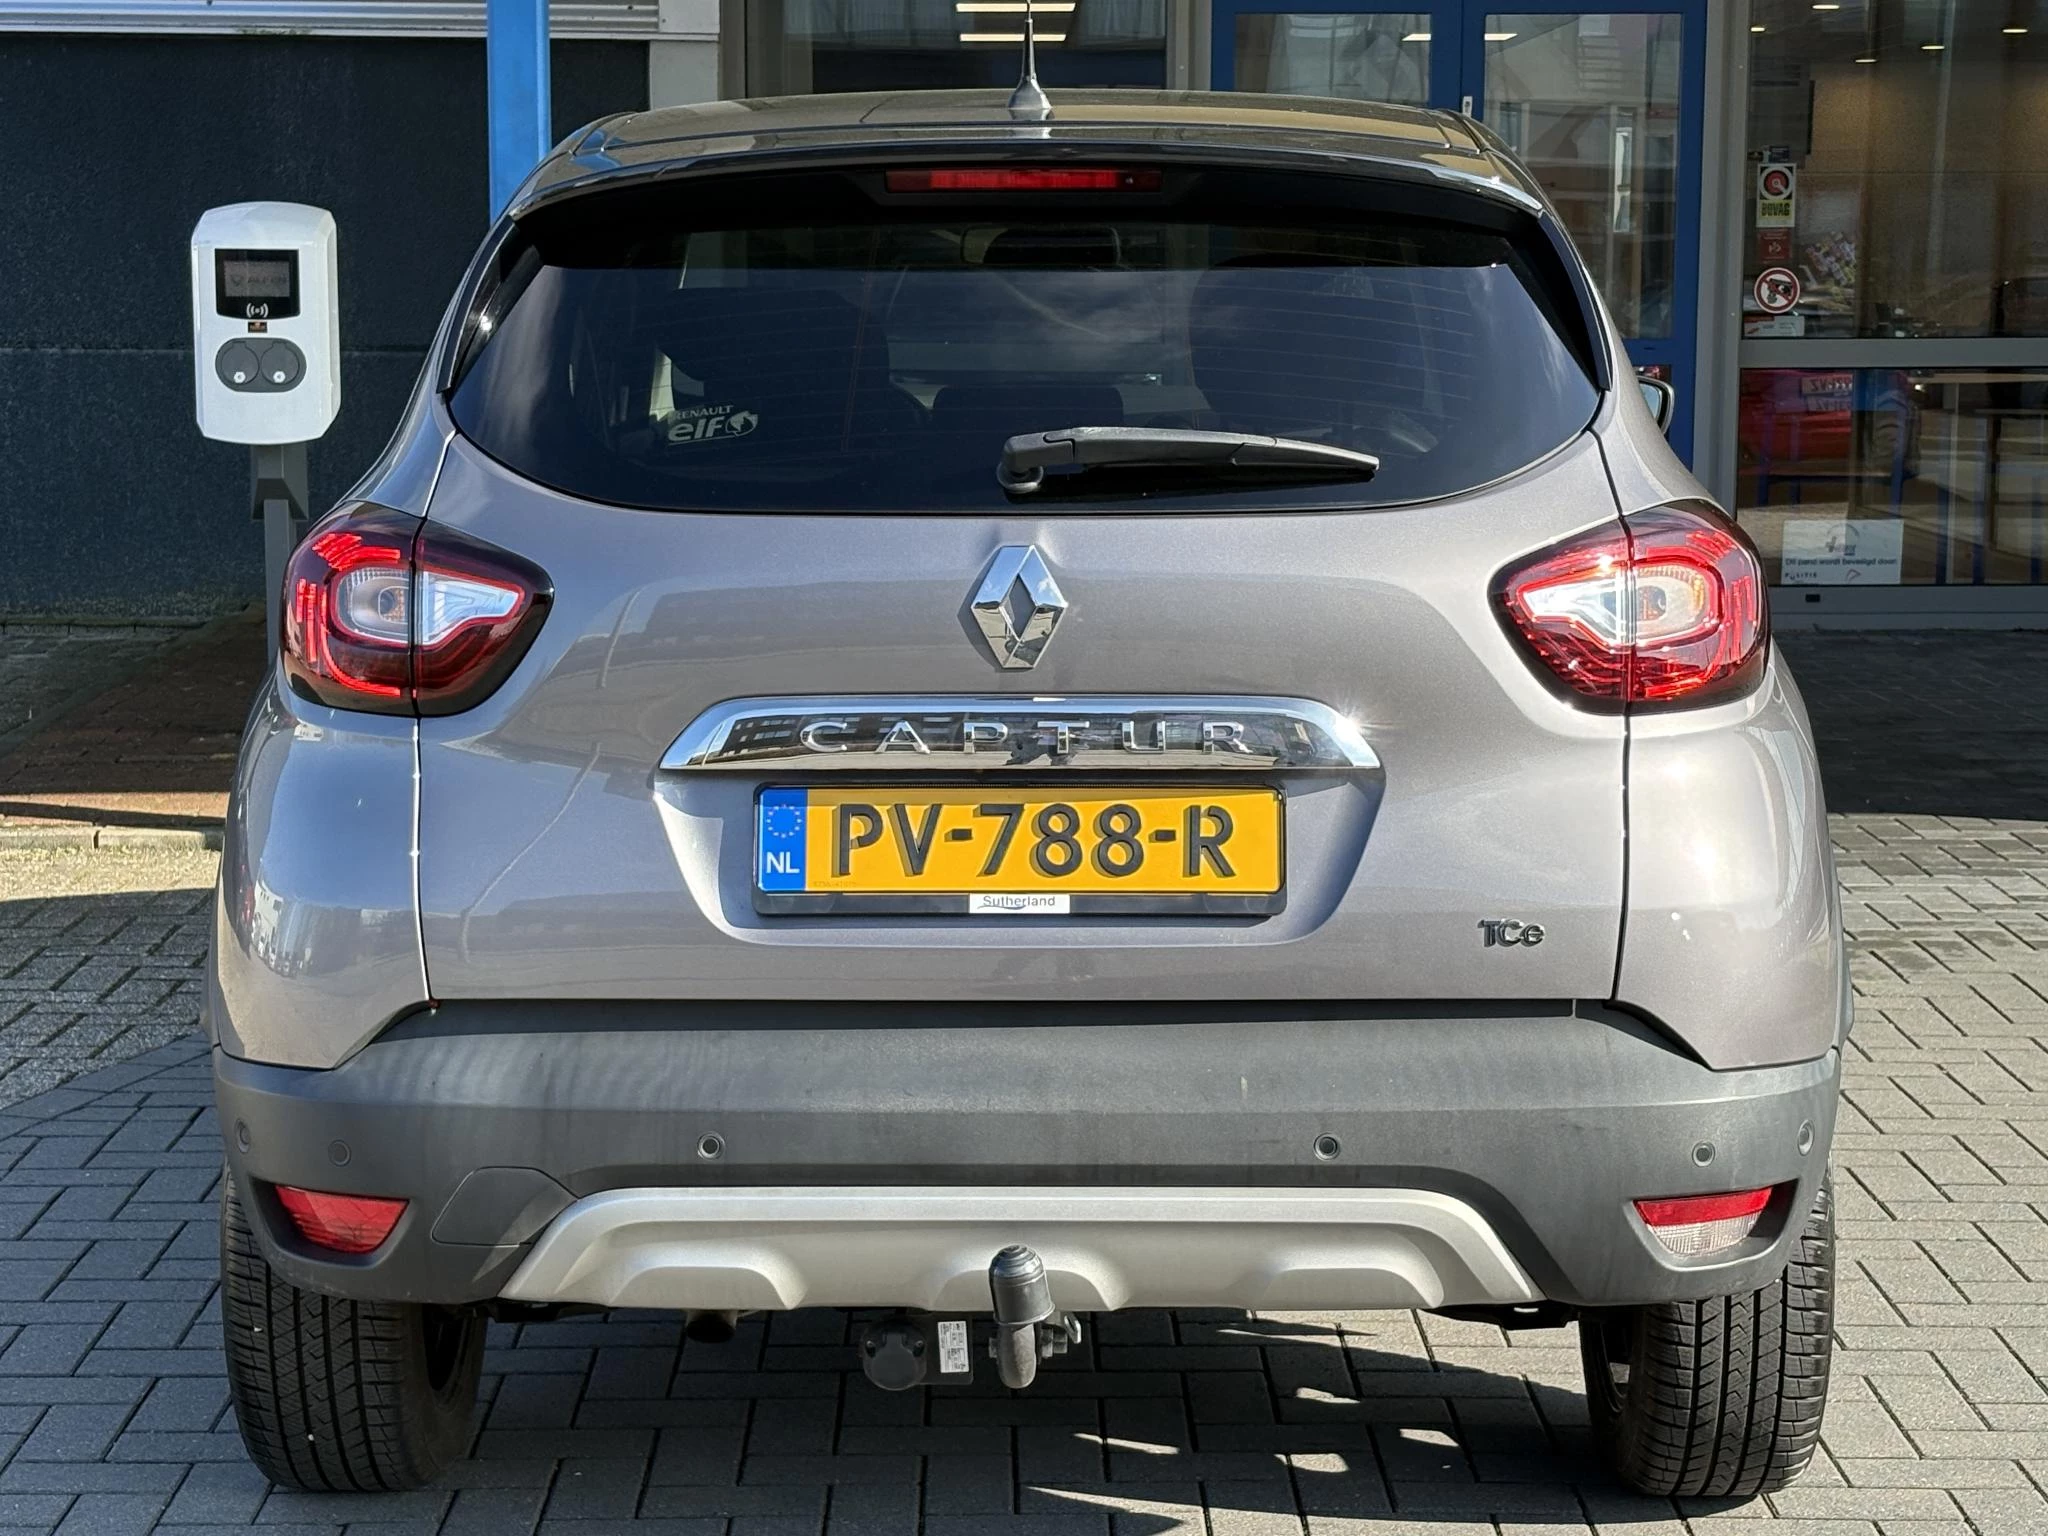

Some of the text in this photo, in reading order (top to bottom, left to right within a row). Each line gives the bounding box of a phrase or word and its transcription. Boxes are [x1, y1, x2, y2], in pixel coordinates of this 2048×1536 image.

[1761, 202, 1790, 217] BOVAG
[668, 416, 725, 441] elf
[799, 720, 1252, 754] CAPTUR
[832, 803, 1236, 878] PV-788-R
[766, 851, 800, 874] NL
[982, 895, 1056, 907] Sutherland
[1477, 919, 1545, 948] TCe
